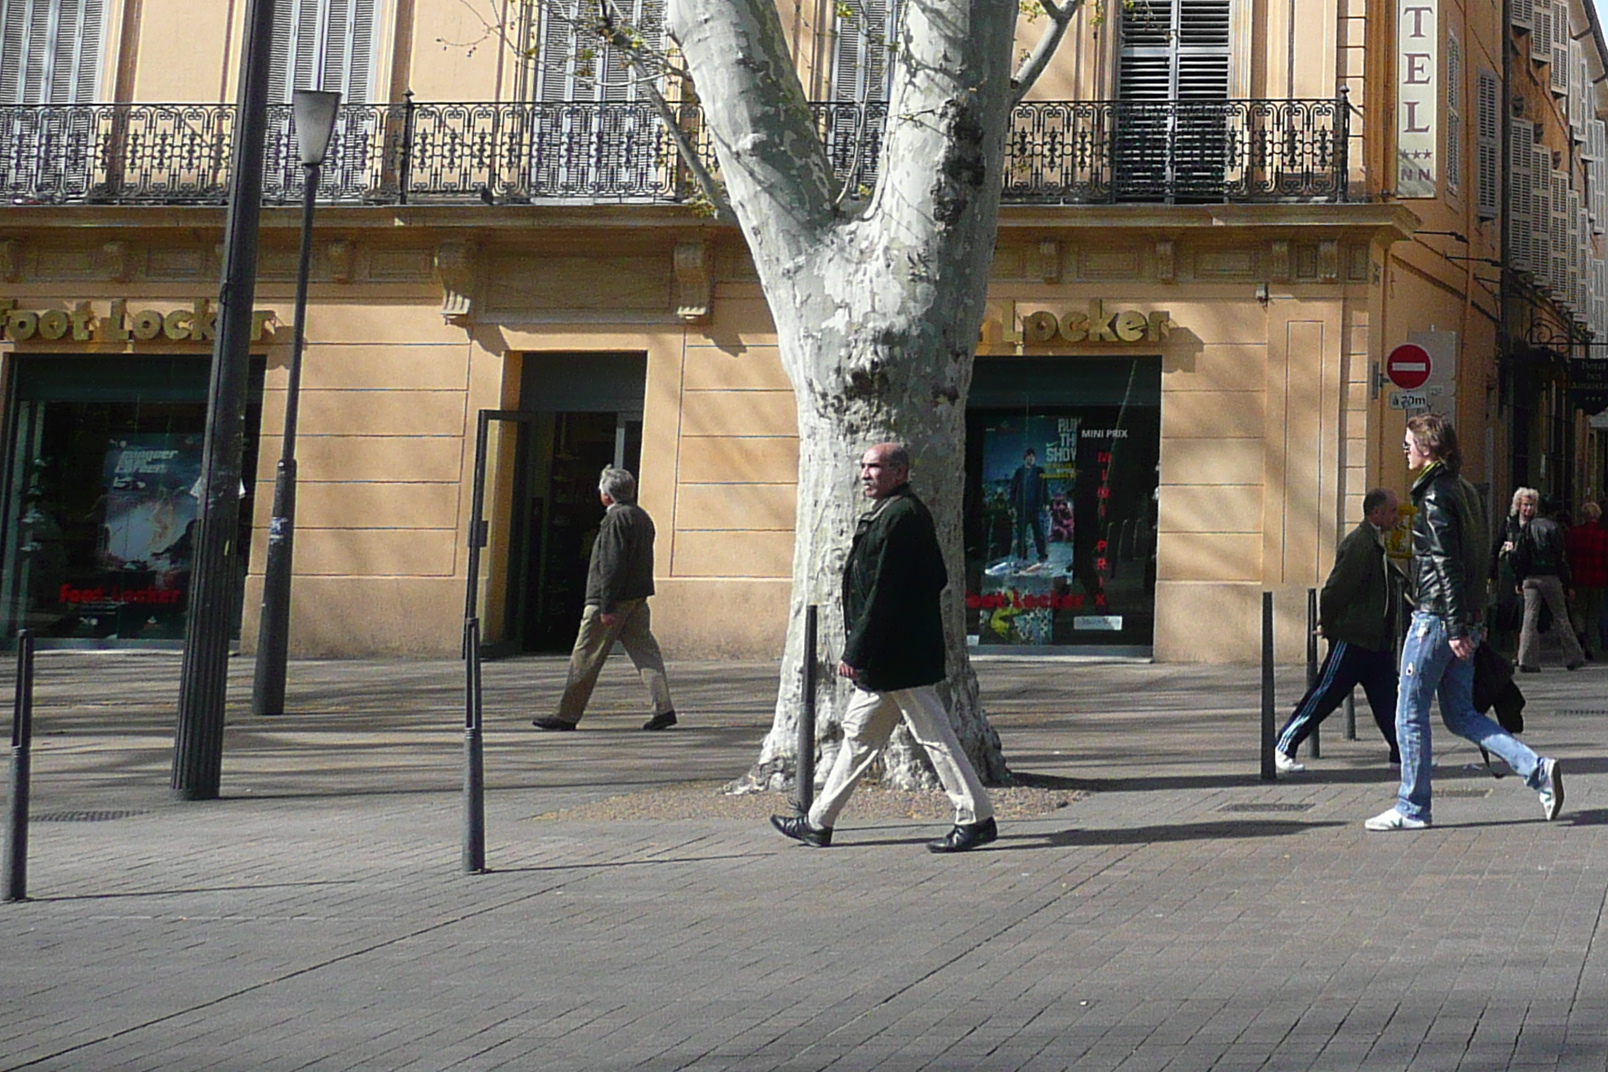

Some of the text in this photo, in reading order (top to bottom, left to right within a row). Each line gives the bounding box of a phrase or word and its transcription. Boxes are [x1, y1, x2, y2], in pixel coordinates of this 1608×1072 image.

[110, 298, 277, 341] Lockr
[1002, 298, 1170, 342] Locker
[1081, 429, 1128, 439] MINI PRIX
